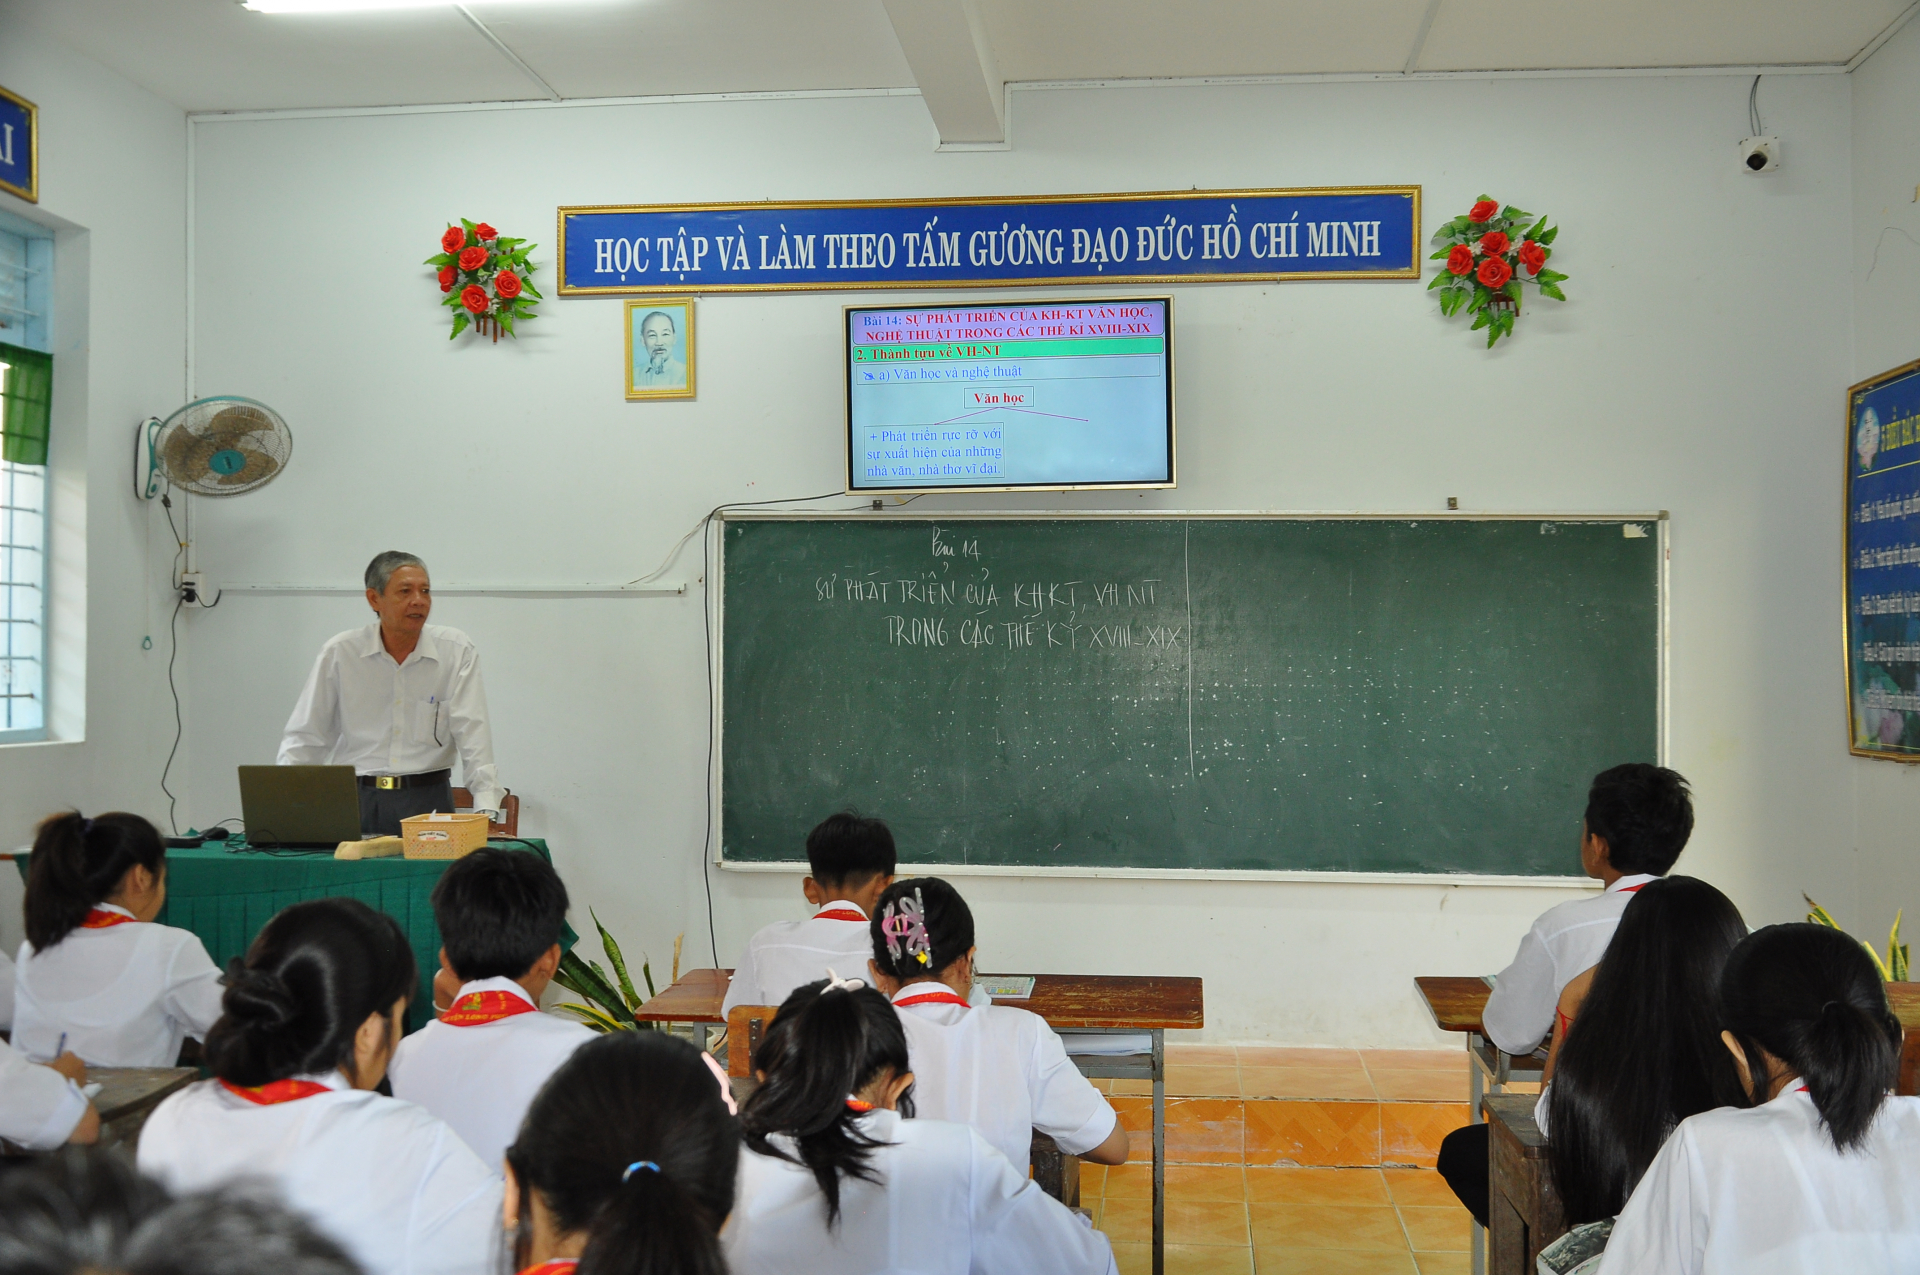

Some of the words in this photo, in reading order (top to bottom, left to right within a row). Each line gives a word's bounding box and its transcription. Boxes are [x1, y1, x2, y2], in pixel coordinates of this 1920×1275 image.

[594, 237, 650, 282] HỌC
[656, 226, 709, 282] TẬP
[715, 224, 751, 272] VÀ
[759, 223, 816, 270] LÀM
[823, 232, 896, 270] THEO
[903, 215, 962, 268] TẤM
[969, 222, 1064, 267] GƯƠNG
[1071, 226, 1129, 272] ĐẠO
[1136, 213, 1194, 261] ĐỨC
[1201, 203, 1242, 260] HỒ
[1249, 210, 1300, 259] CHÍ
[1306, 220, 1382, 257] MINH
[864, 315, 882, 326] Bài
[886, 315, 902, 326] 14:
[905, 312, 924, 327] SỰ
[927, 310, 963, 324] PHÁT
[1010, 308, 1038, 321] CỦA
[1041, 309, 1084, 321] KH-KT
[1088, 306, 1116, 319] VĂN
[1120, 306, 1153, 320] HỌC,
[866, 329, 904, 343] NGHỆ
[906, 327, 953, 342] THUẬT
[955, 326, 1003, 340] TRONG
[1006, 324, 1035, 338] CÁC
[1088, 322, 1151, 335] XVIII-XIX
[857, 349, 867, 360] 2.
[871, 348, 911, 360] Thành
[914, 349, 935, 361] tựu
[939, 343, 953, 357] về
[956, 344, 1002, 357] VH-NT
[879, 369, 890, 382] a)
[894, 368, 917, 380] Văn
[921, 367, 941, 381] học
[945, 366, 958, 378] và
[962, 365, 990, 381] nghệ
[993, 364, 1022, 379] thuật
[974, 392, 999, 404] Văn
[1003, 392, 1025, 406] học
[882, 430, 907, 442] Phát
[911, 426, 937, 441] triển
[942, 431, 961, 442] rực
[965, 429, 979, 440] rỡ
[983, 427, 1001, 439] với
[867, 450, 880, 461] sự
[884, 444, 909, 459] xuất
[913, 446, 937, 460] hiện
[941, 446, 961, 458] của
[965, 445, 1002, 459] những
[867, 465, 888, 477] nhà
[891, 465, 916, 477] văn,
[919, 463, 939, 475] nhà
[943, 463, 962, 475] thơ
[965, 463, 977, 474] vĩ
[979, 461, 1001, 475] đại.
[962, 536, 982, 562] 14
[966, 567, 1001, 607] CỦA
[882, 615, 949, 648] TRONG
[960, 609, 995, 649] CÁC
